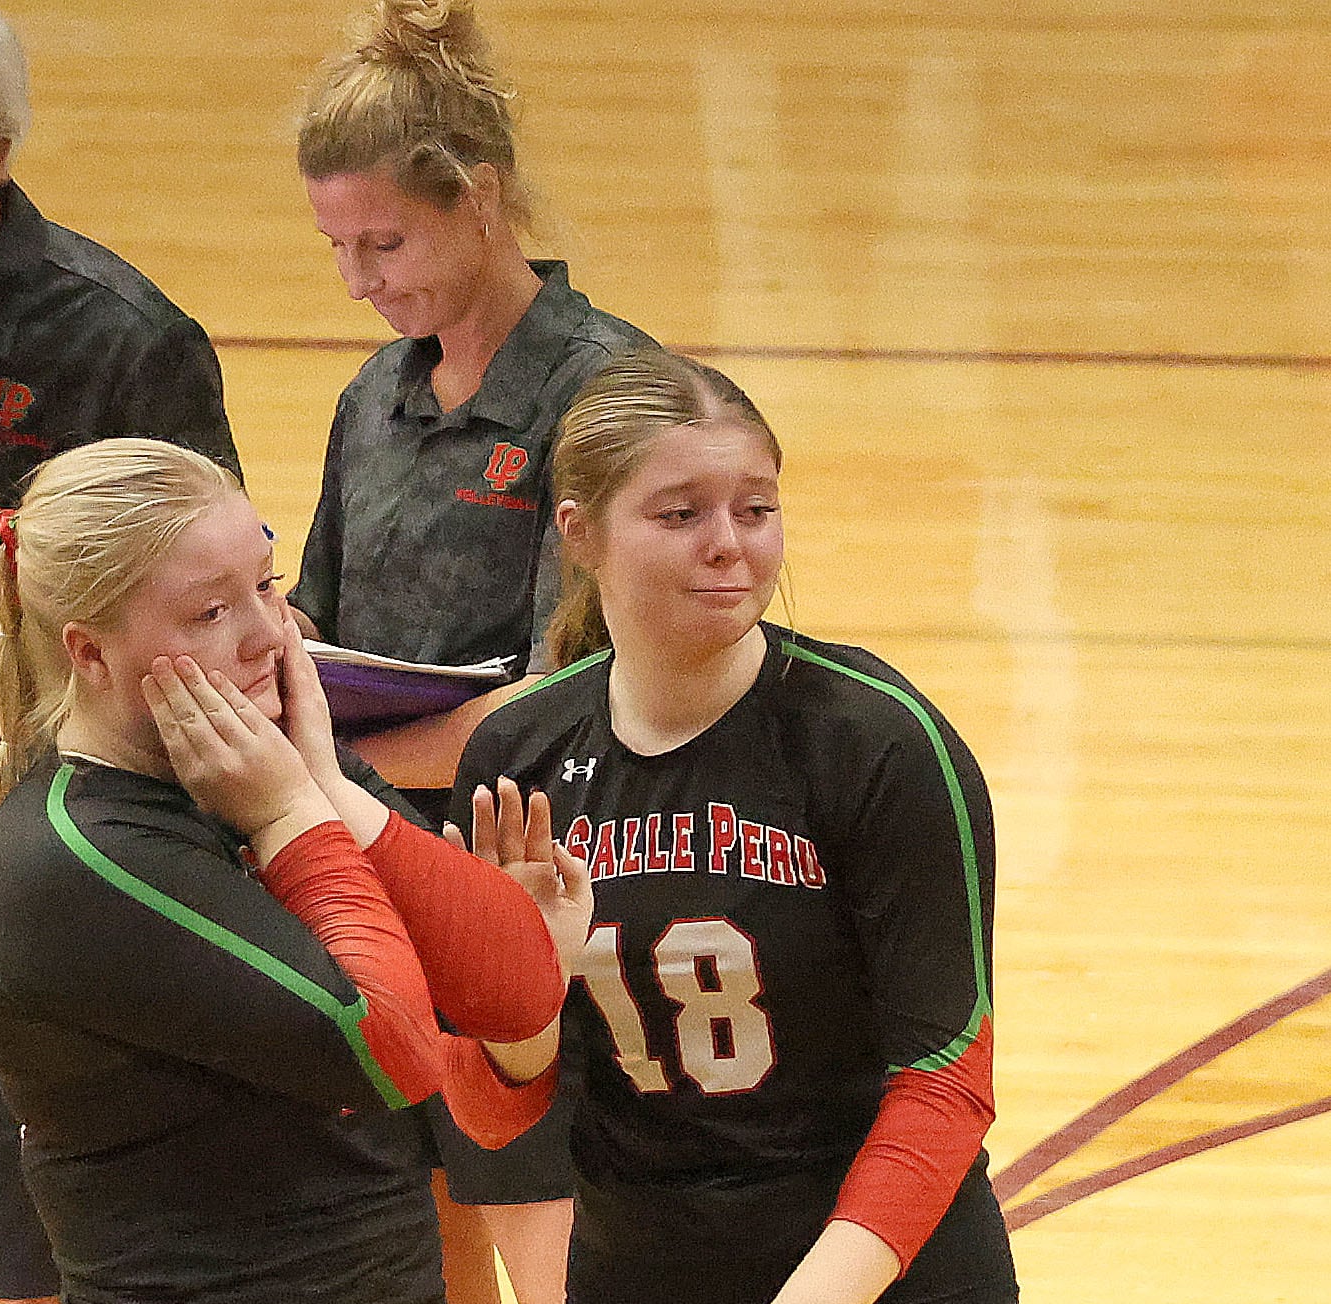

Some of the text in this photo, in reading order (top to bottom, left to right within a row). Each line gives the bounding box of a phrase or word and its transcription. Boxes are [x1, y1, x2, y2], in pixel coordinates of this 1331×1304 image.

[483, 442, 528, 490] LP
[552, 801, 826, 889] SALLE PERU
[570, 916, 778, 1097] 18
